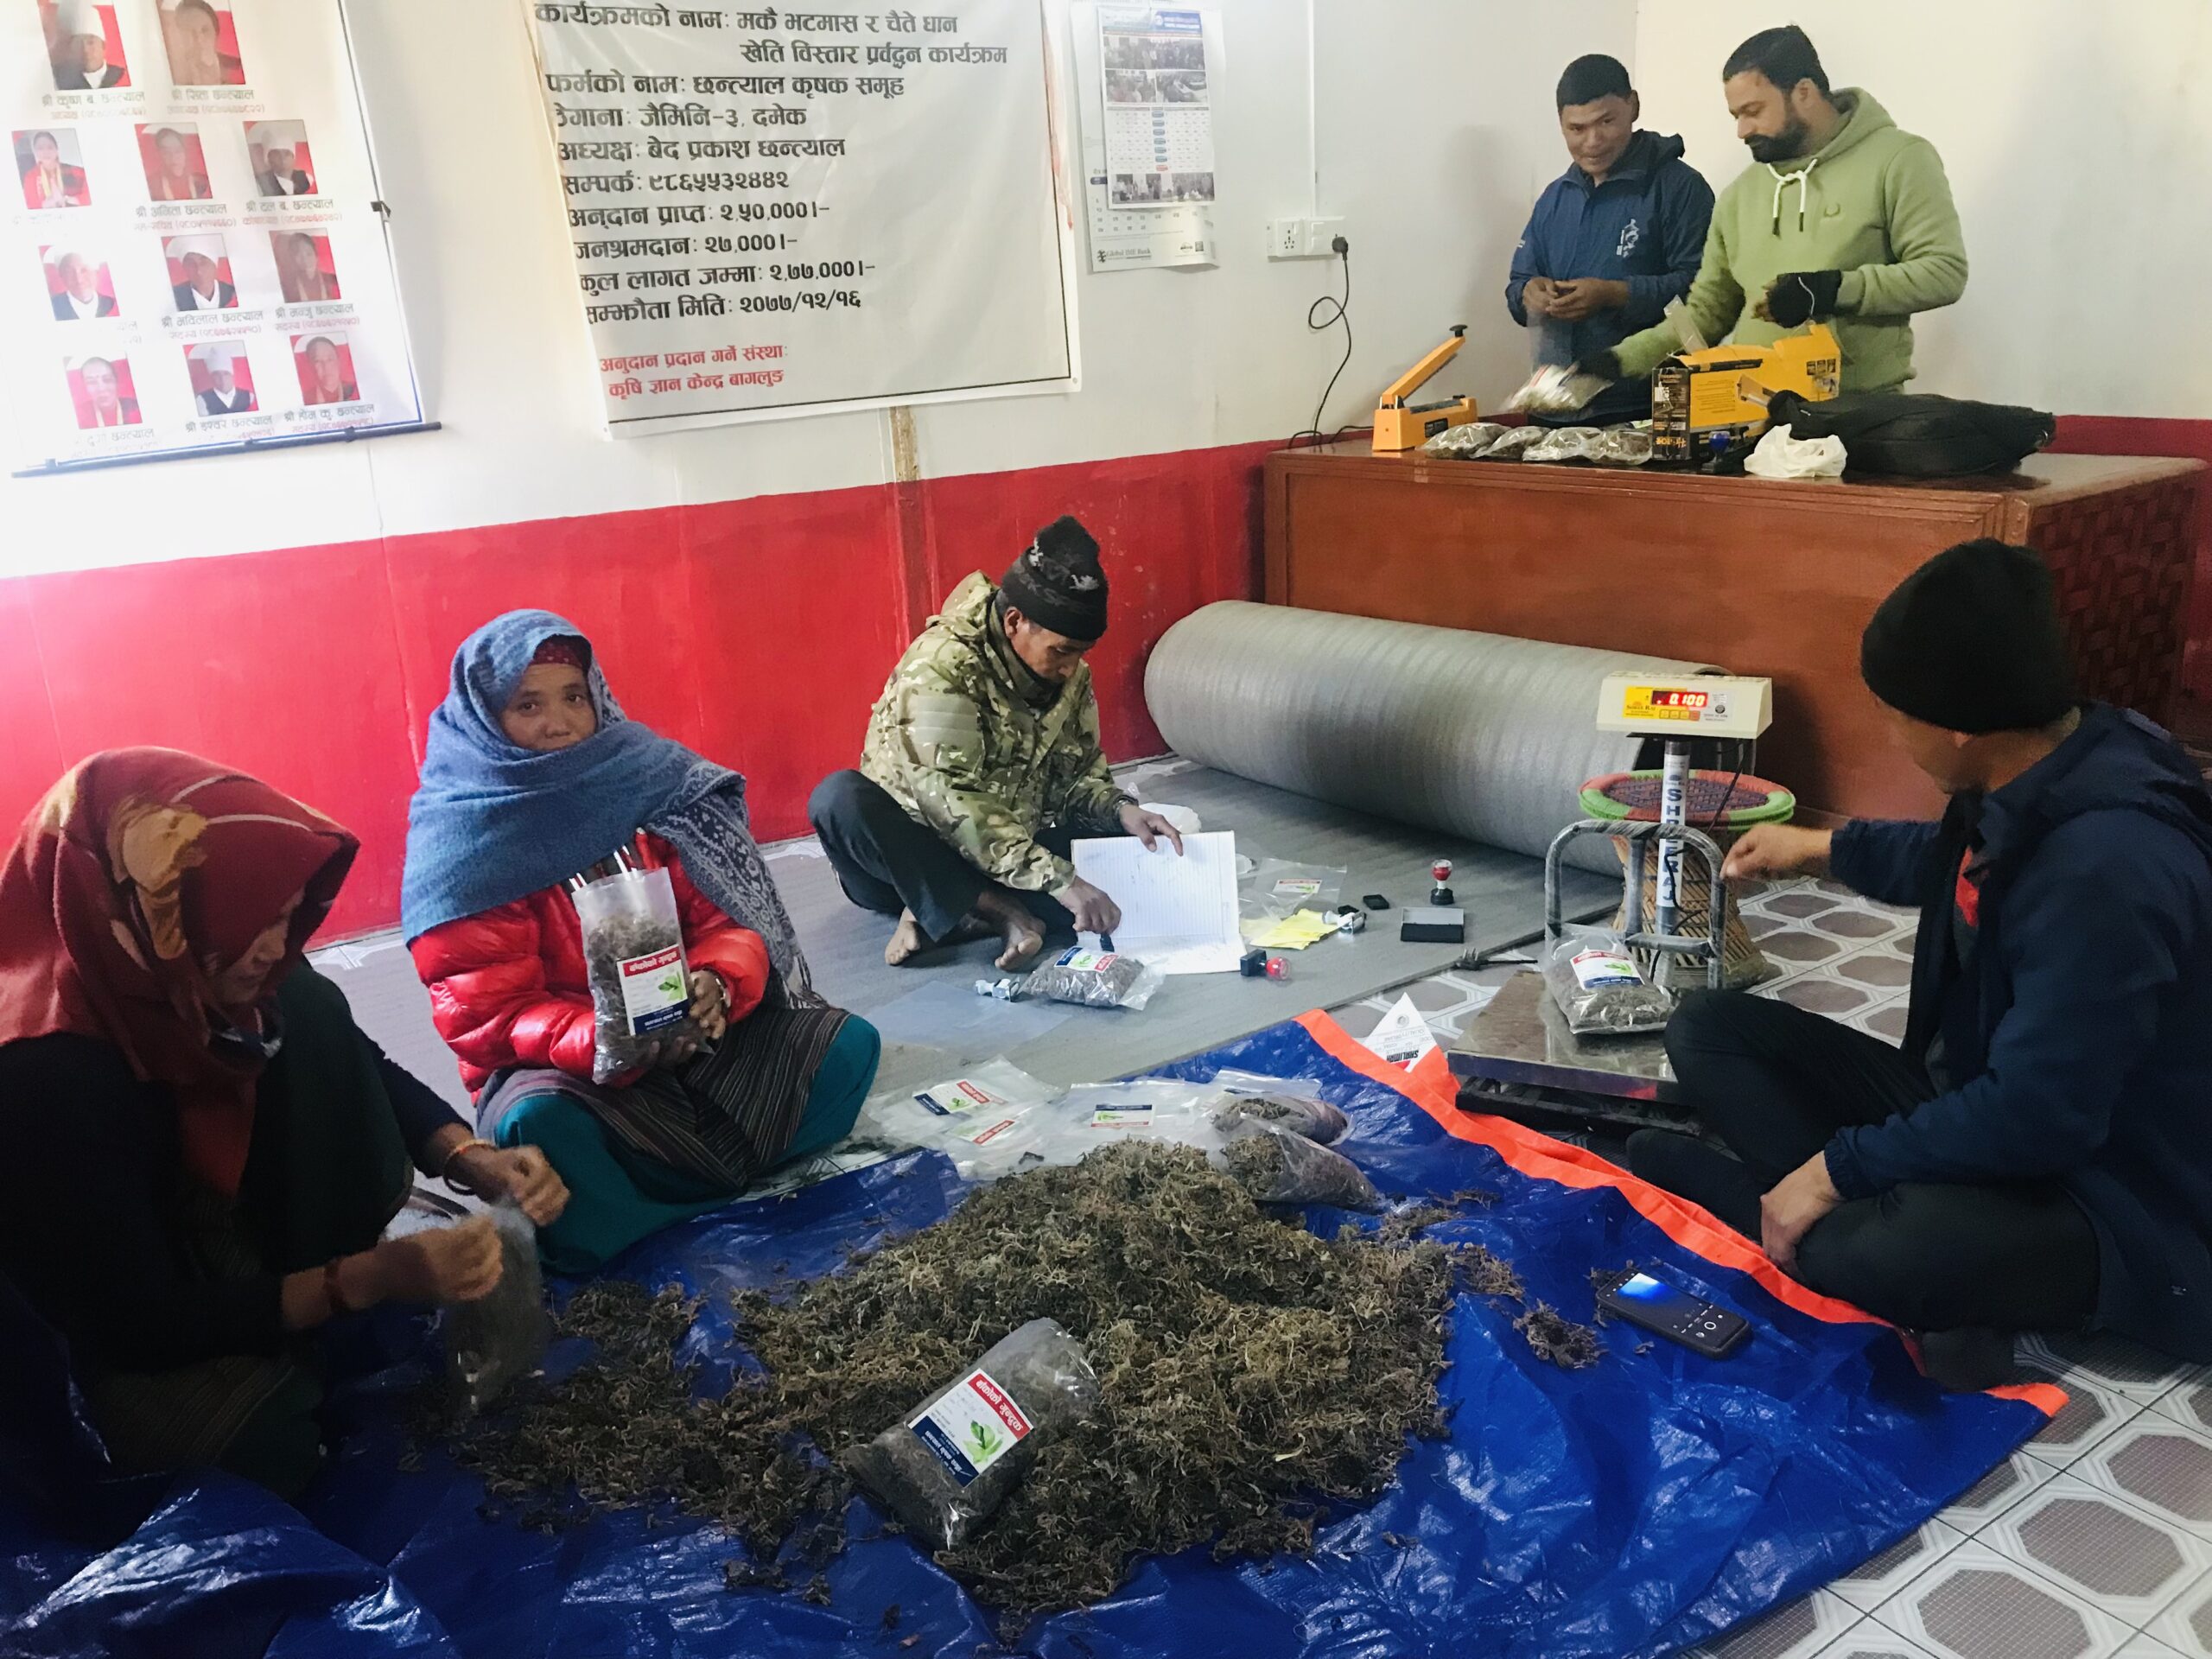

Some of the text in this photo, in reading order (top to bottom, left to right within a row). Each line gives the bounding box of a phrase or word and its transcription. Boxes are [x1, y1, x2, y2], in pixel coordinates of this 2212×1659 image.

[737, 7, 777, 30] मकै
[785, 12, 859, 33] भटमास
[864, 16, 880, 33] र
[886, 10, 917, 33] चैते
[923, 16, 958, 33] धान
[740, 39, 785, 63] खेति
[791, 39, 860, 64] विस्तार
[545, 68, 625, 92] फर्मको
[693, 76, 785, 94] छन्त्याल
[791, 77, 849, 99] कृषक
[855, 77, 905, 99] समूह
[751, 103, 807, 126] दमेक
[647, 136, 679, 159] बेद
[687, 140, 750, 161] प्रकाश
[758, 138, 845, 159] छन्त्याल
[626, 269, 691, 289] लागत
[600, 353, 659, 374] अनुदान
[664, 351, 706, 369] प्रदान
[609, 369, 785, 399] कृषि ज्ञान केन्द्र बागलुङ
